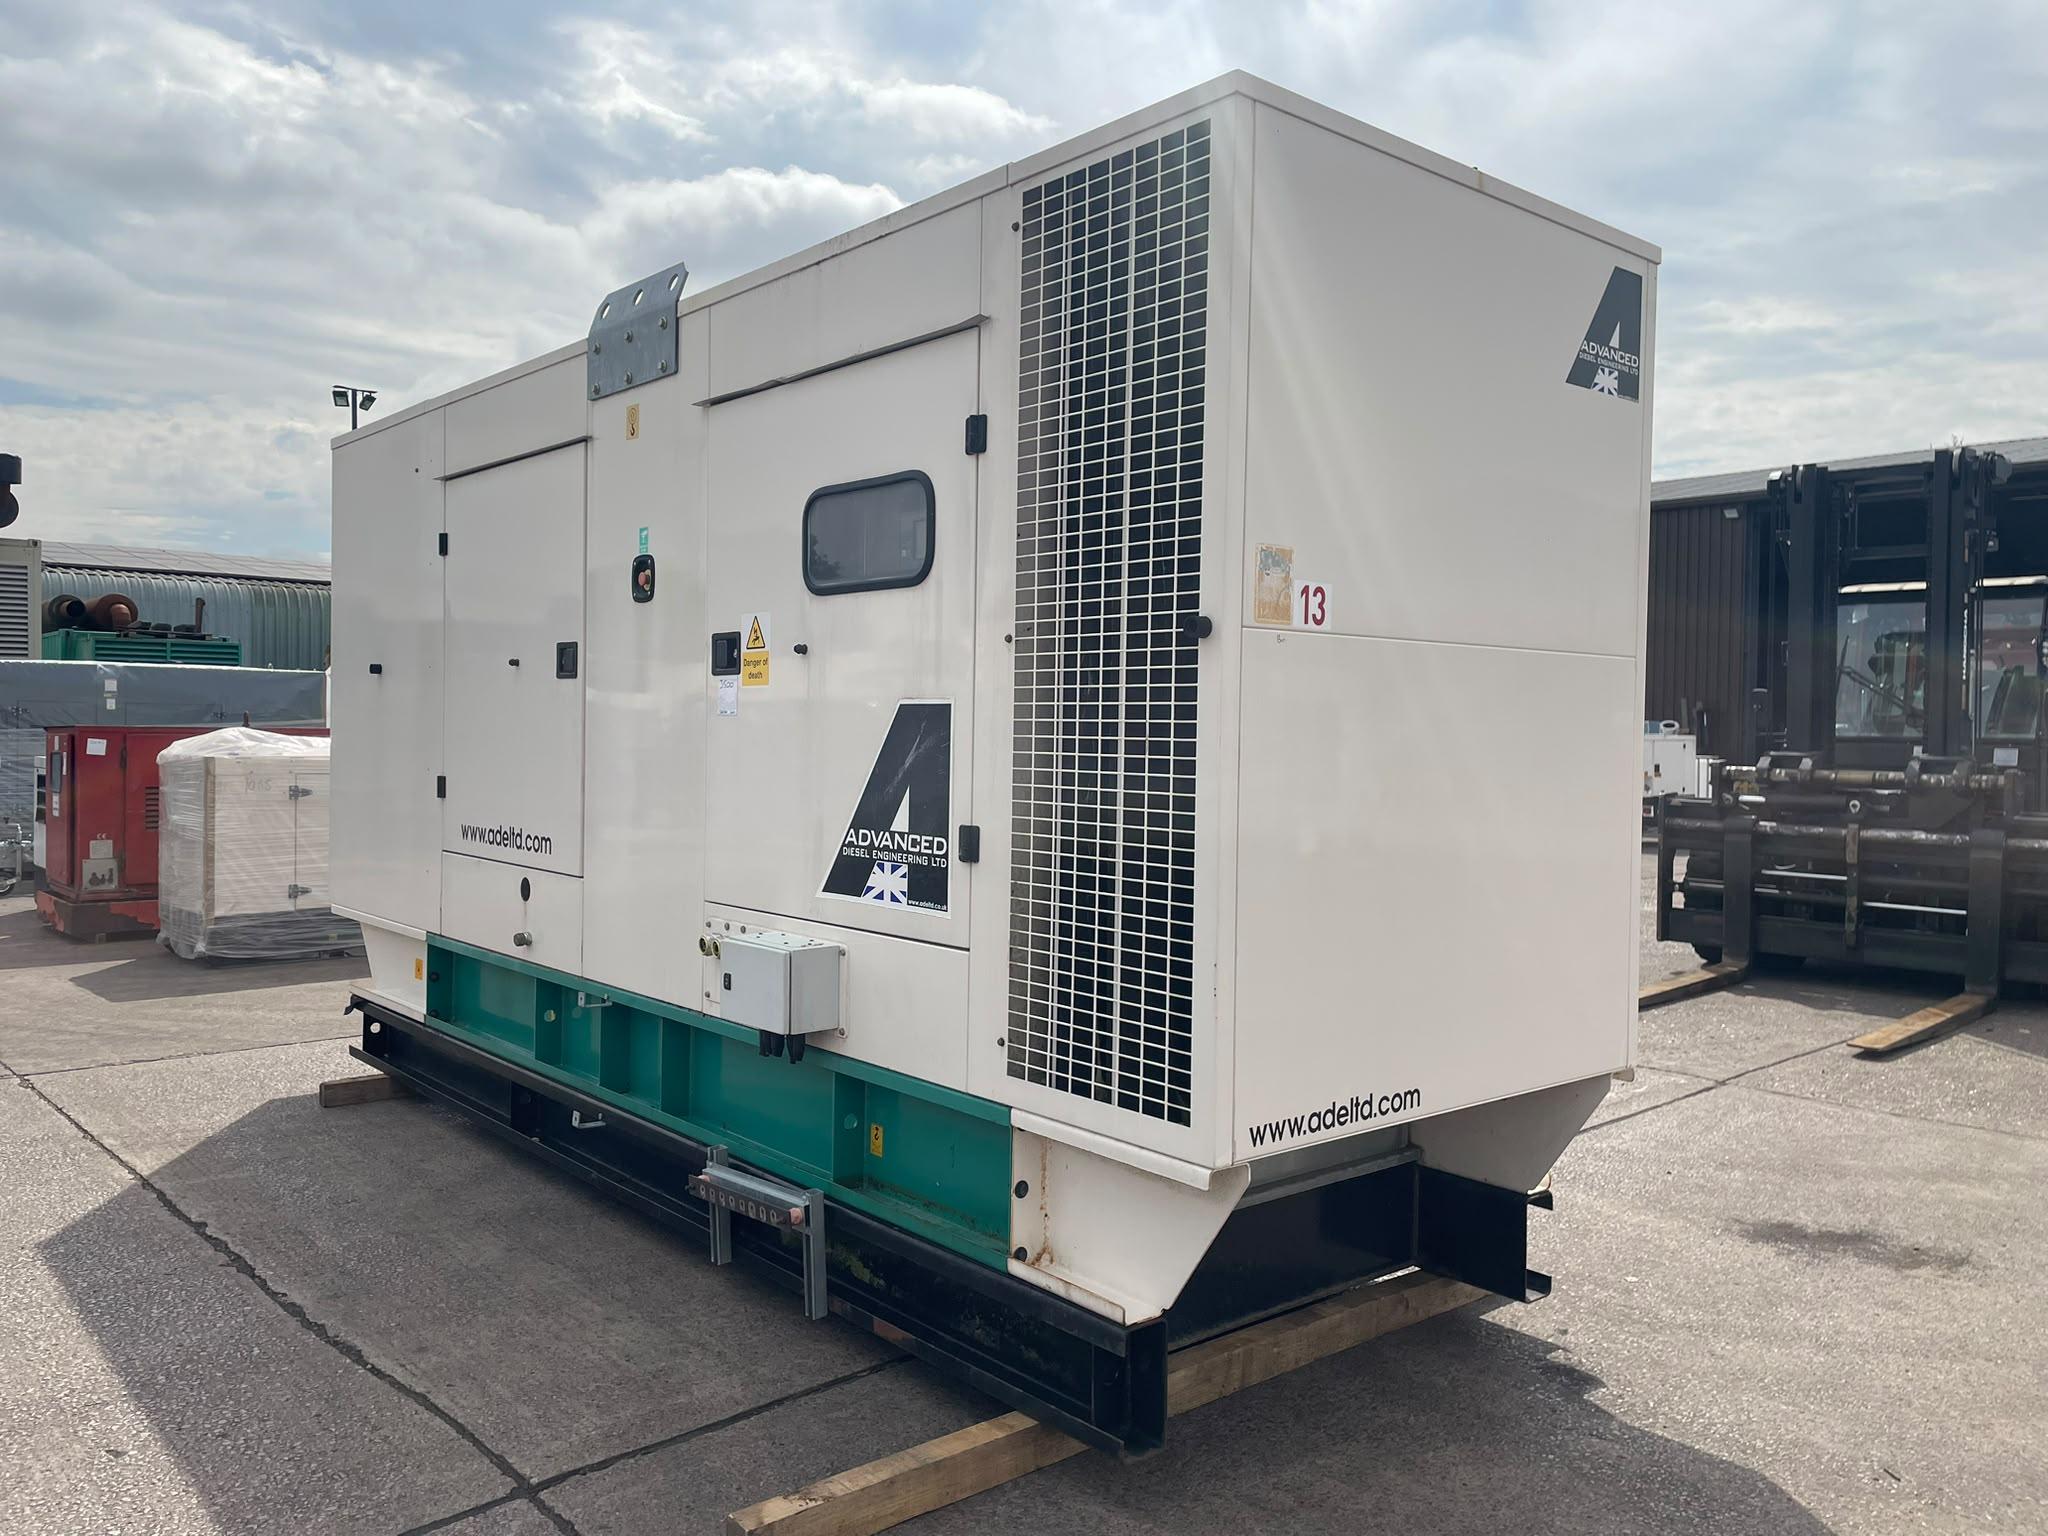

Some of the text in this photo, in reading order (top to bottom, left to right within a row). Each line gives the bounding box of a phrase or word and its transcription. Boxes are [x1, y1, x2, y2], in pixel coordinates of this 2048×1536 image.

[1580, 340, 1639, 368] ADVANCED
[1300, 584, 1326, 626] 13
[743, 658, 769, 669] Danger of
[747, 671, 763, 680] death
[461, 824, 552, 855] www.adeltd.com
[844, 828, 948, 856] ADVANCED
[842, 846, 948, 868] DIESEL ENGINEERING LTD
[1249, 1088, 1421, 1147] www.adeltd.com
